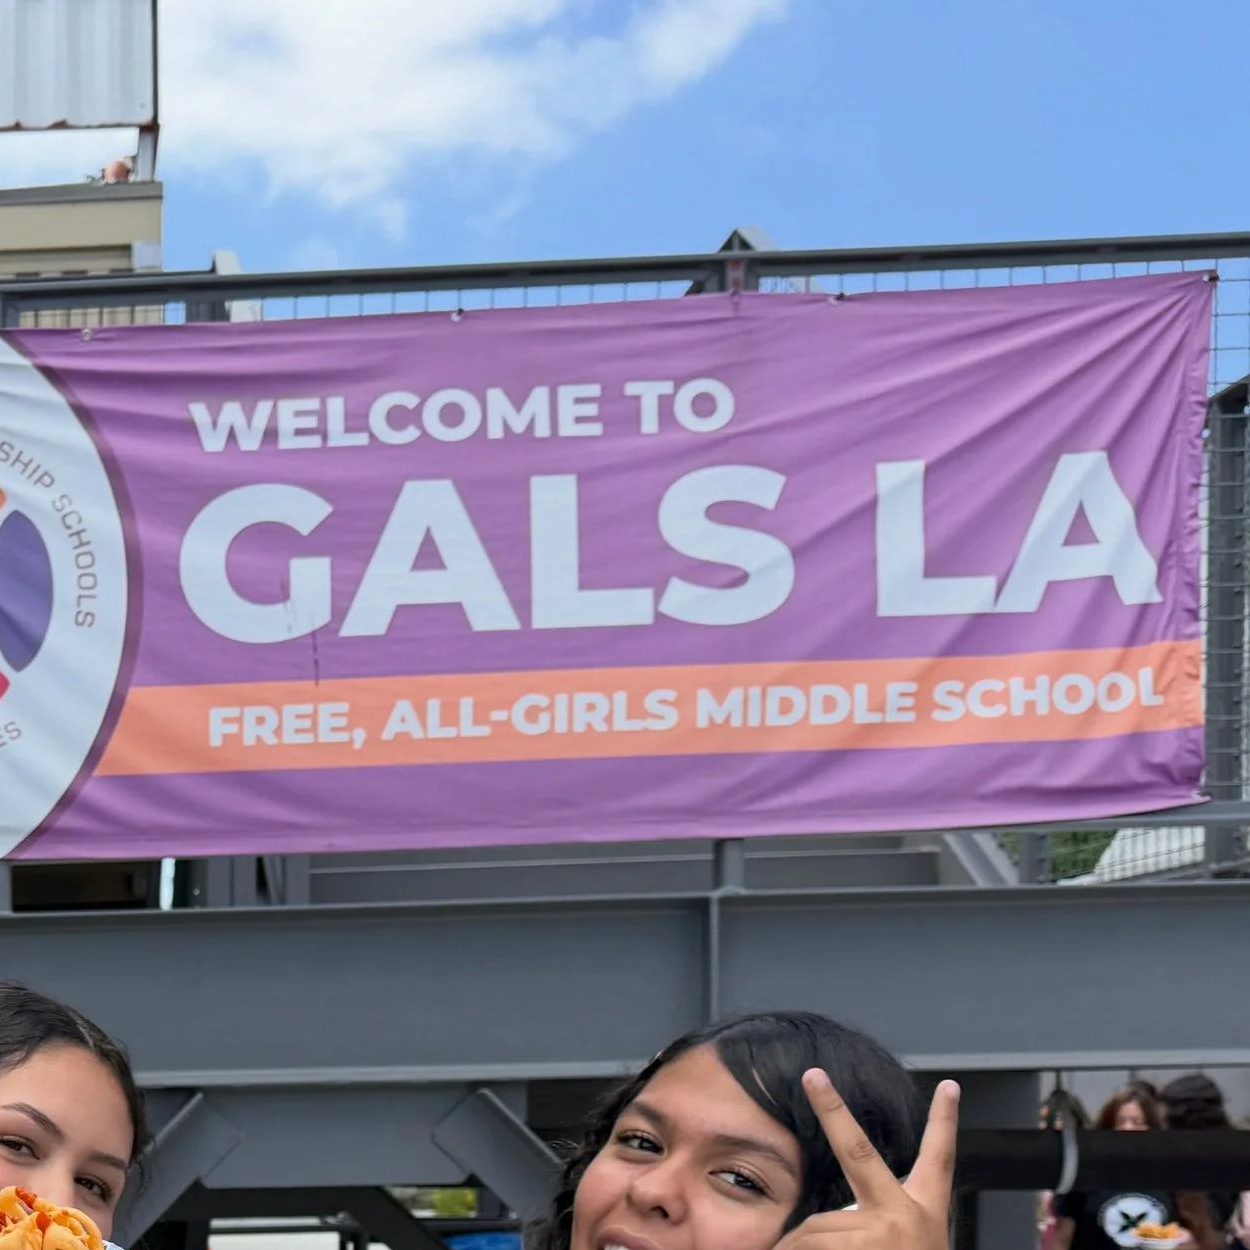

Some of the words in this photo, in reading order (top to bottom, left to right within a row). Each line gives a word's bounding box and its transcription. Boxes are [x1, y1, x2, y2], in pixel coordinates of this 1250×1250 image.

[188, 382, 603, 452] WELCOME
[623, 377, 736, 434] TO
[52, 494, 97, 628] SCHOOLS
[179, 464, 795, 644] GALS
[876, 450, 1163, 617] LA
[208, 702, 367, 750] FREE,
[381, 689, 679, 741] ALL-GIRLS
[696, 682, 918, 729] MIDDLE
[931, 667, 1165, 723] SCHOOL
